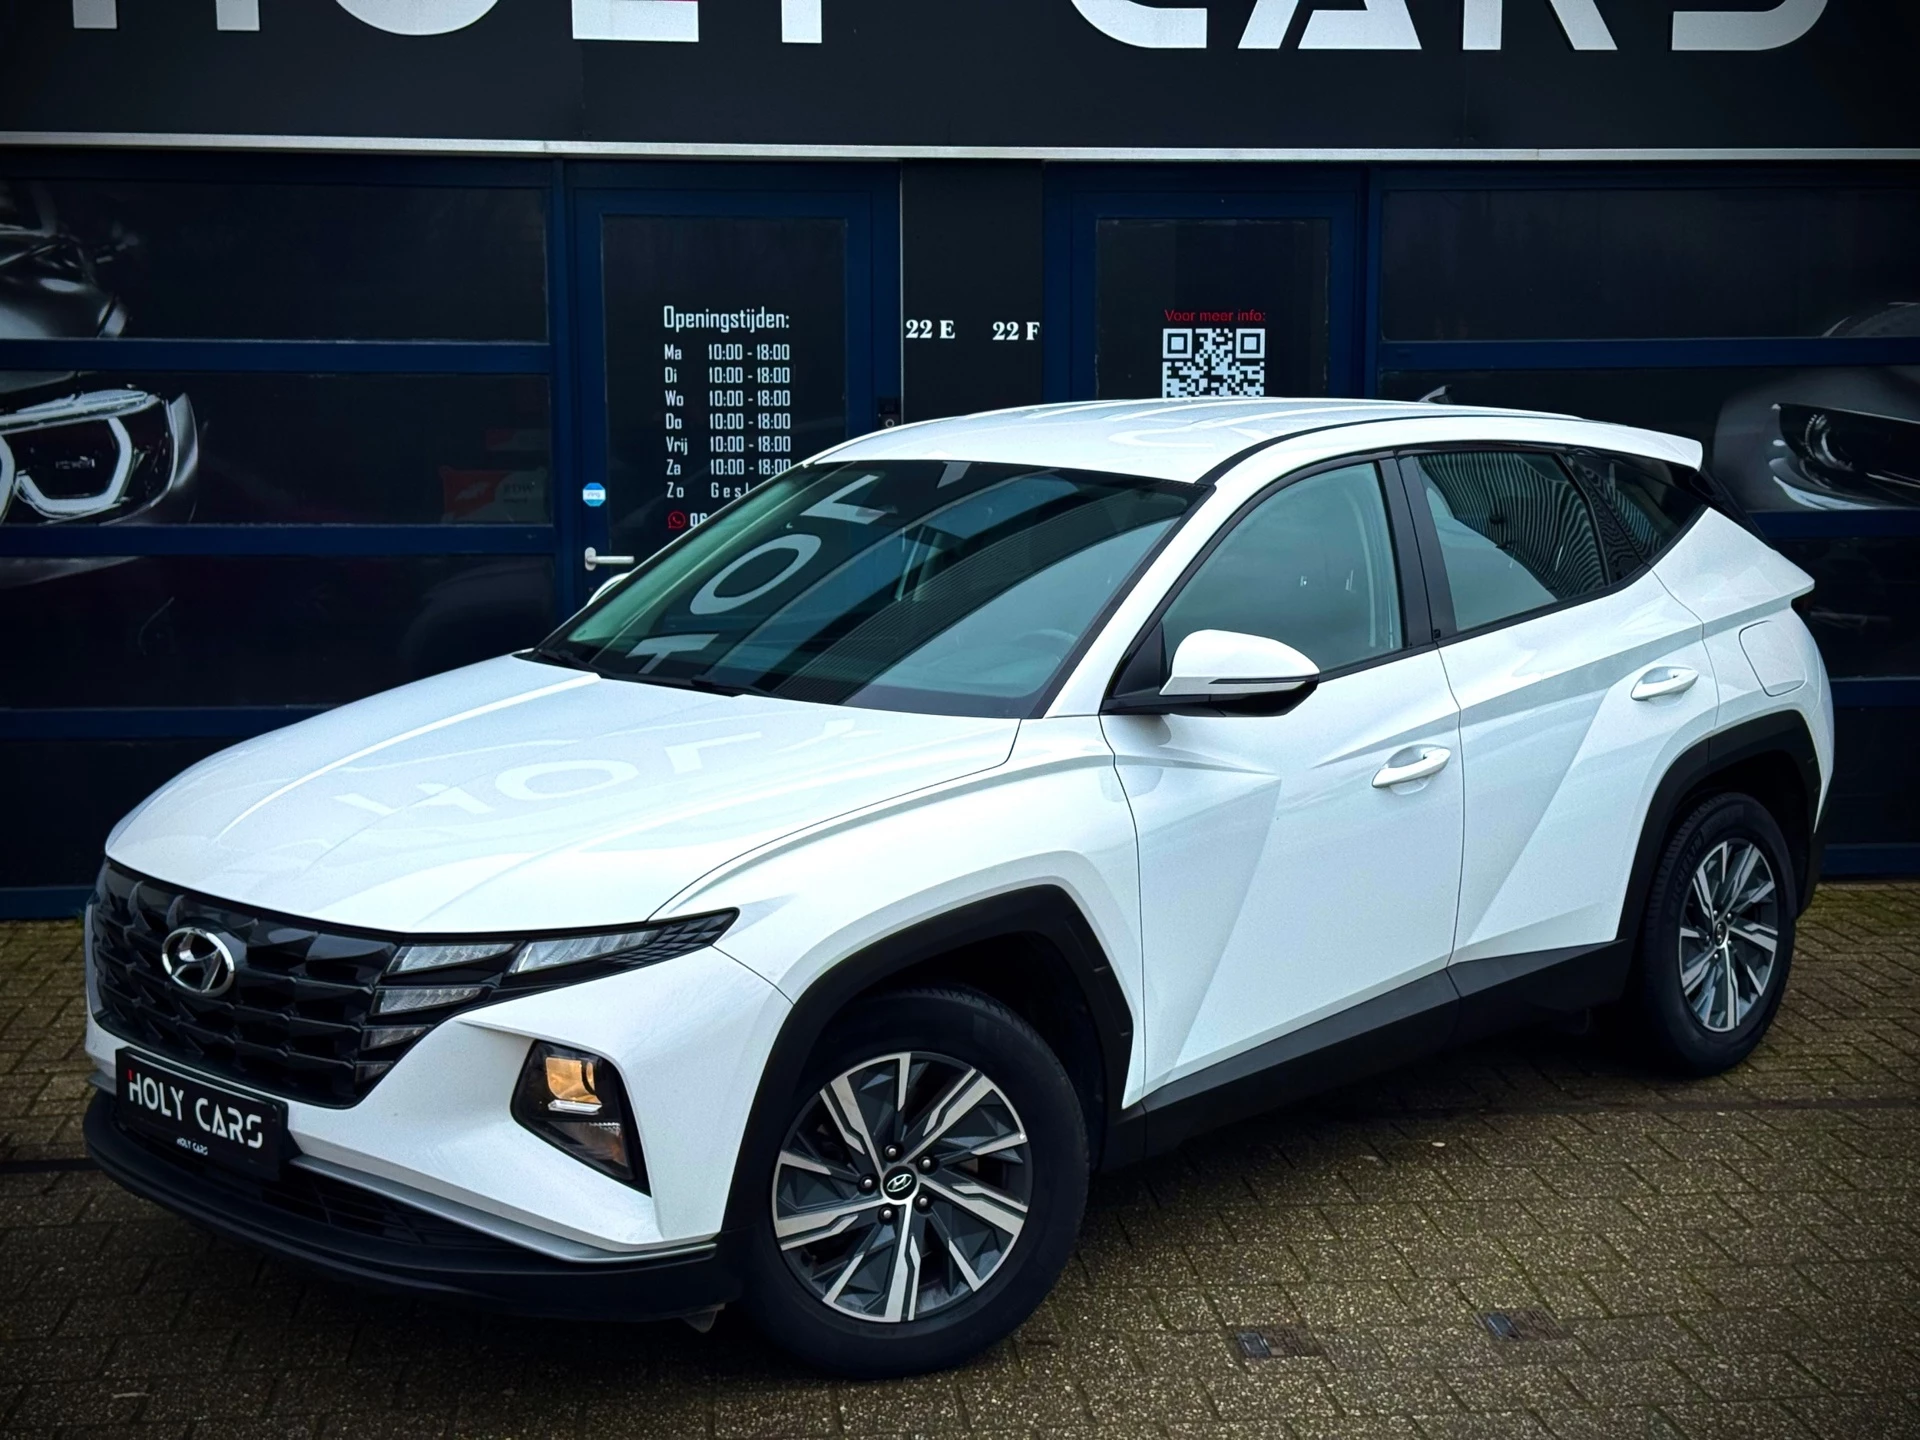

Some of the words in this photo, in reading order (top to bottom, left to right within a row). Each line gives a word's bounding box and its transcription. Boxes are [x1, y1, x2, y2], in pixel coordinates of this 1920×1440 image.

[664, 305, 790, 333] Openingstijden:
[1165, 309, 1195, 321] Voor
[1200, 312, 1233, 321] meer
[1238, 309, 1266, 321] info:
[905, 319, 933, 339] 22
[940, 319, 956, 339] E
[992, 321, 1019, 341] 22
[1026, 321, 1041, 341] F
[664, 343, 682, 361] Ma
[708, 343, 743, 361] 10:00
[756, 343, 791, 361] 18:00
[664, 366, 678, 384] Di
[708, 366, 743, 384] 10:00
[757, 366, 791, 384] 18:00
[665, 389, 684, 407] Wo
[709, 389, 744, 407] 10:00
[757, 389, 791, 407] 18:00
[665, 412, 683, 430] Do
[709, 412, 744, 430] 10:00
[758, 412, 791, 430] 18:00
[666, 435, 688, 455] Vrij
[710, 435, 745, 453] 10:00
[758, 435, 791, 453] 18:00
[666, 458, 682, 476] Za
[710, 458, 745, 476] 10:00
[758, 458, 791, 476] 18:00
[666, 481, 685, 499] Zo
[127, 1069, 185, 1122] HOLY
[195, 1097, 264, 1149] CARS
